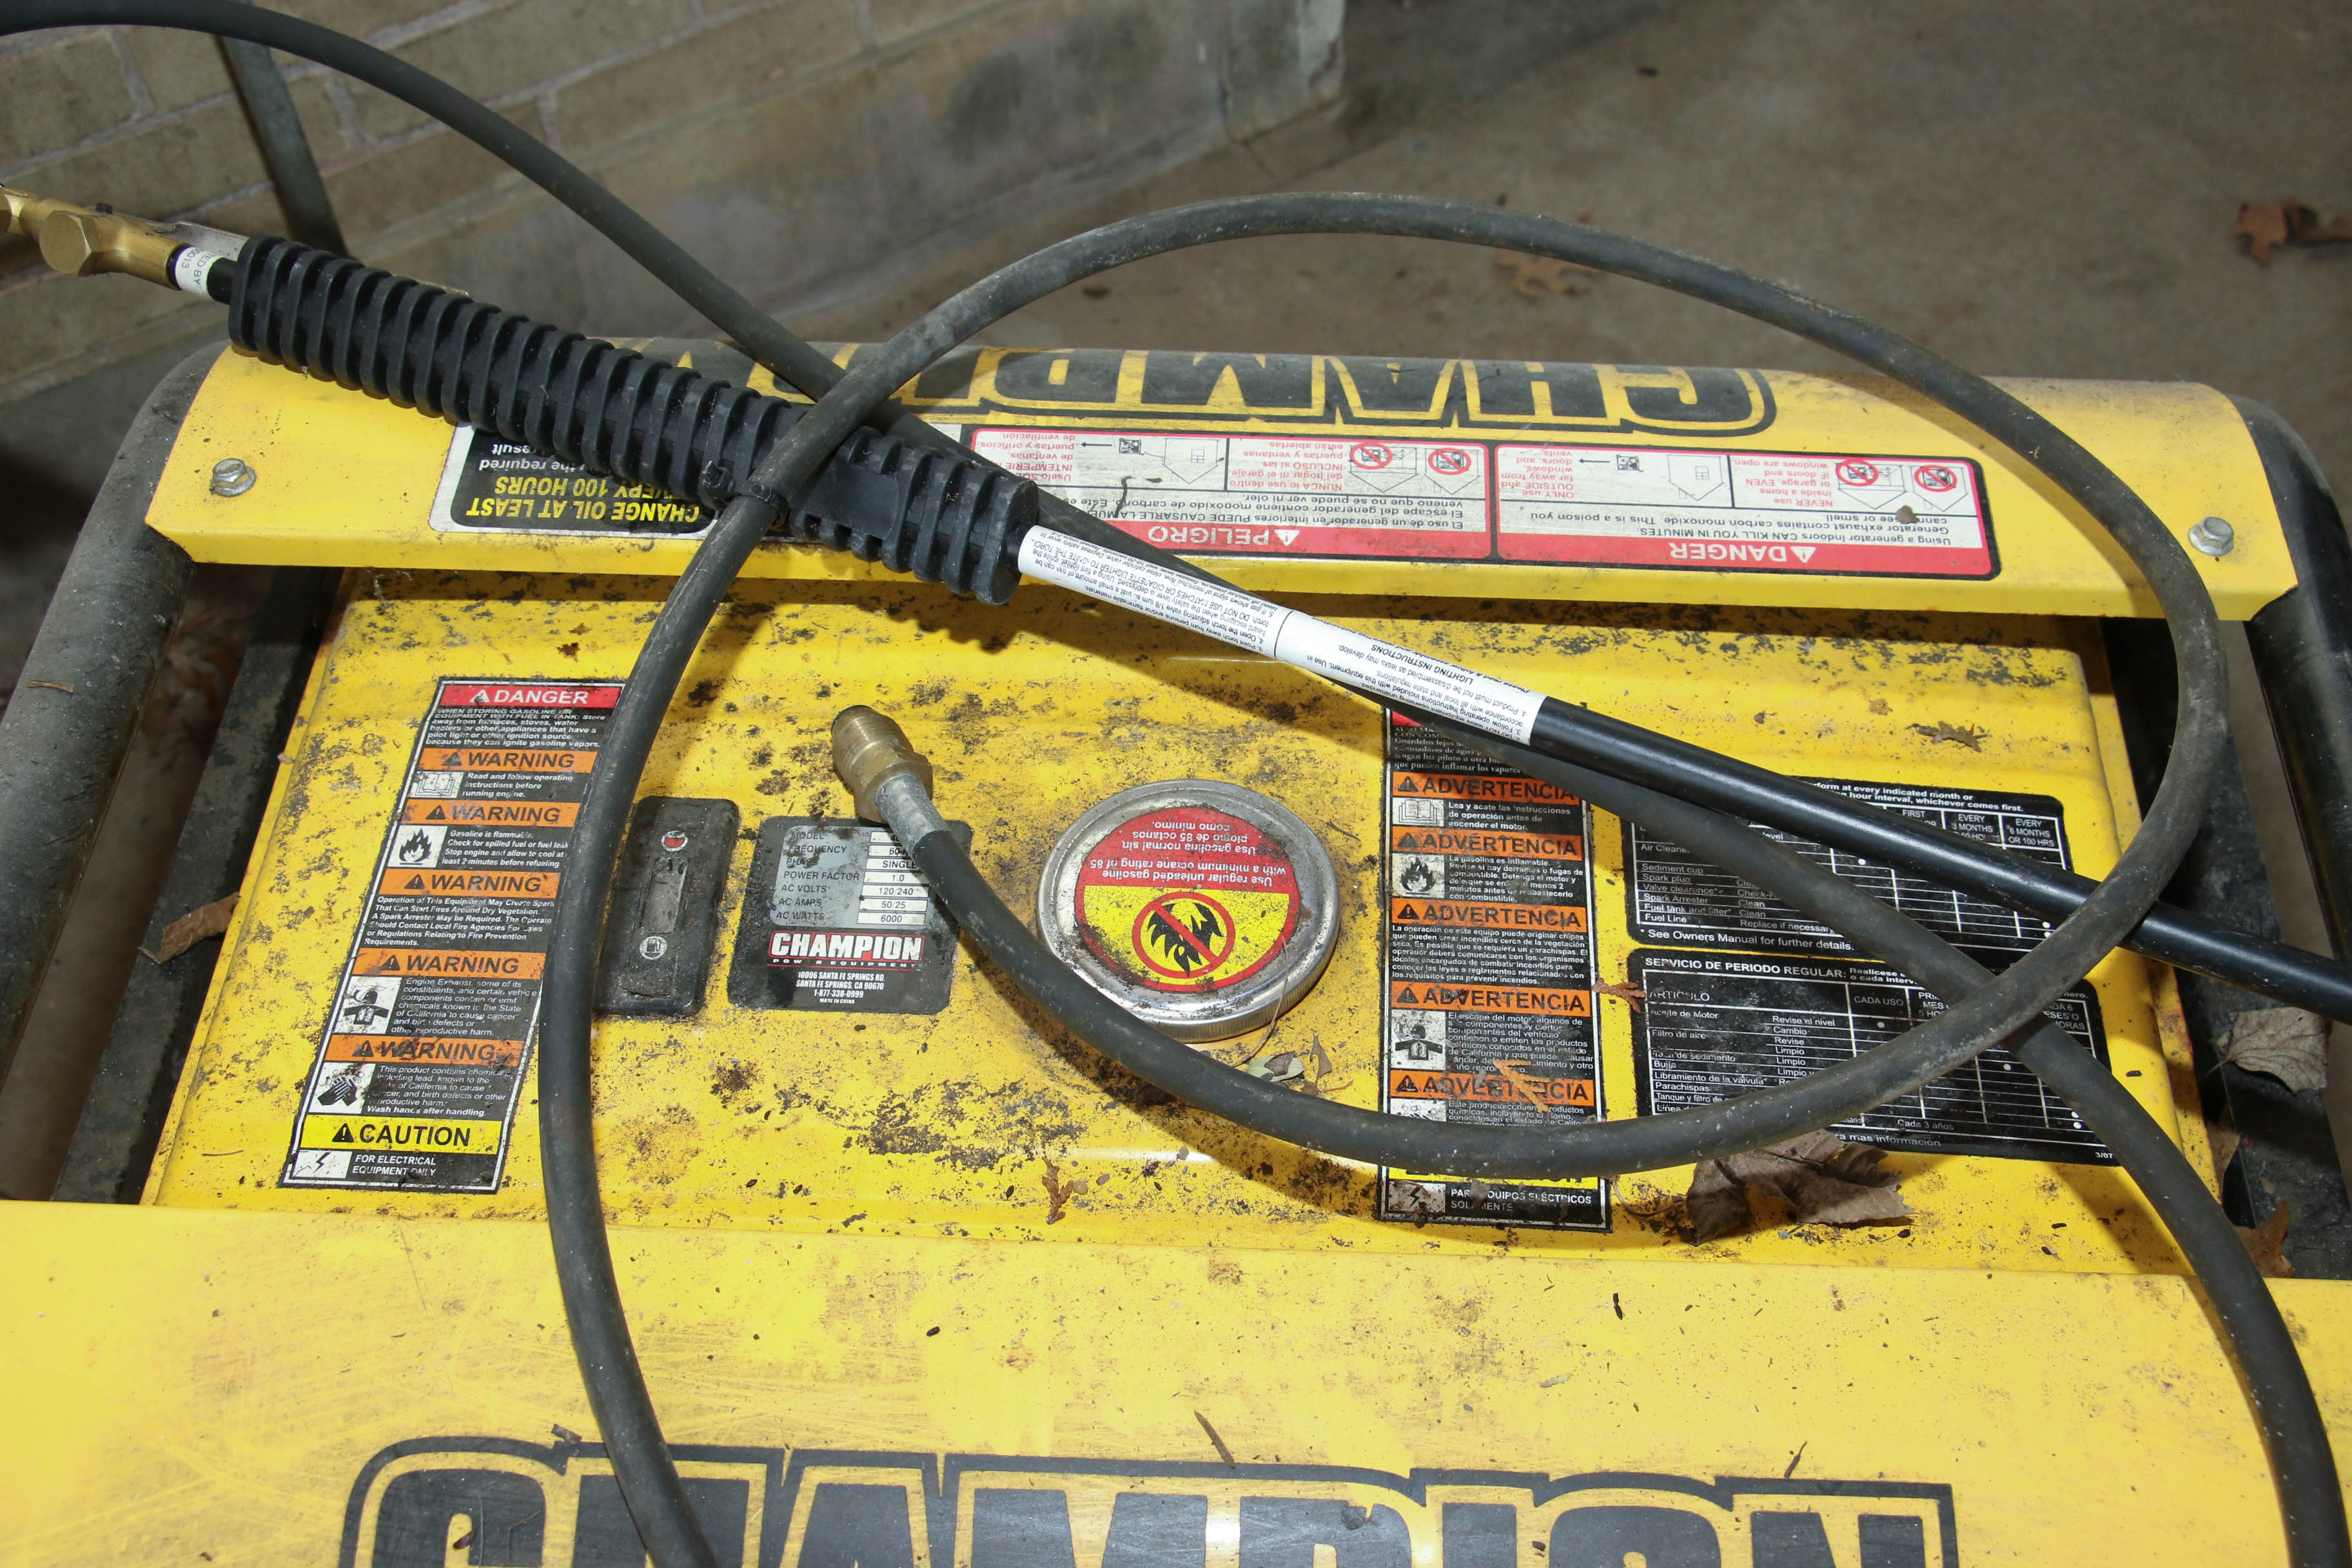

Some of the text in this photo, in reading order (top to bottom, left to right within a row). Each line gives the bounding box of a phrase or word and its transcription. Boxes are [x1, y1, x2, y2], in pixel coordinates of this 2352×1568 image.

[479, 459, 546, 471] required
[495, 476, 569, 496] HOURS
[573, 478, 608, 497] 100
[466, 497, 700, 523] CHANGE OIL AT LEAST
[1254, 514, 1312, 524] interiores
[1531, 511, 1553, 520] you
[1558, 513, 1600, 522] poison
[1631, 515, 1655, 524] This
[1660, 516, 1725, 525] monoxide.
[1333, 517, 1388, 526] generador
[1731, 519, 1772, 528] carbon
[1777, 521, 1831, 530] contains
[1637, 527, 1694, 536] MINUTES.
[1835, 523, 1883, 532] exhaust
[1888, 524, 1949, 534] Generator
[1148, 526, 1269, 545] PELIGRO
[1698, 529, 1710, 538] IN
[1714, 529, 1738, 538] YOU
[1743, 531, 1768, 540] KILL
[1772, 532, 1798, 540] CAN
[1850, 534, 1903, 544] generator
[1918, 536, 1951, 546] Using
[1671, 542, 1787, 561] DANGER
[1371, 644, 1474, 685] LIGHTING INSTRUCTIONS
[494, 690, 589, 704] DANGER
[468, 752, 575, 768] WARNING
[1422, 778, 1575, 799] ADVERTENCIA
[1916, 797, 2024, 812] whichever comes first.
[451, 806, 560, 822] WARNING
[2015, 819, 2042, 828] EVERY
[1133, 831, 1177, 839] octanos
[2016, 828, 2050, 838] MONTHS
[485, 840, 511, 848] spilled
[1142, 841, 1182, 850] normal
[1423, 834, 1578, 856] ADVERTENCIA
[2008, 836, 2021, 845] OR
[2037, 838, 2054, 847] HRS
[789, 845, 847, 854] FREQUENCY
[1184, 844, 1232, 853] gasolina
[1235, 846, 1256, 855] Use
[1090, 859, 1104, 868] 85
[1106, 859, 1117, 868] of
[1121, 859, 1153, 868] rating
[1157, 861, 1194, 870] octane
[1198, 863, 1250, 872] minimum
[1263, 865, 1286, 875] with
[783, 871, 818, 880] POWER
[821, 872, 860, 881] FACTOR
[1102, 869, 1273, 887] Use regular unleaded gasoline
[431, 875, 542, 892] WARNING
[781, 884, 795, 892] AC
[879, 887, 914, 896] 120/240
[1644, 894, 1670, 903] Spark
[1423, 904, 1581, 927] ADVERTENCIA
[1648, 930, 1854, 950] See Owners Manual for further details.
[770, 932, 922, 961] CHAMPION
[407, 956, 519, 974] WARNING
[1645, 957, 1847, 979] SERVICIO DE PERIODO REGULAR:
[814, 990, 864, 998] 1-877-338-0999
[1423, 988, 1584, 1012] ADVERTENCIA
[380, 1041, 496, 1061] WARNING
[1423, 1076, 1589, 1101] ADVERTCIA
[1655, 1081, 1710, 1092] Parachispas
[367, 1105, 391, 1113] Wash
[446, 1108, 487, 1117] handling.
[360, 1124, 471, 1147] CAUTION
[355, 1155, 436, 1165] FOR ELECTRICAL
